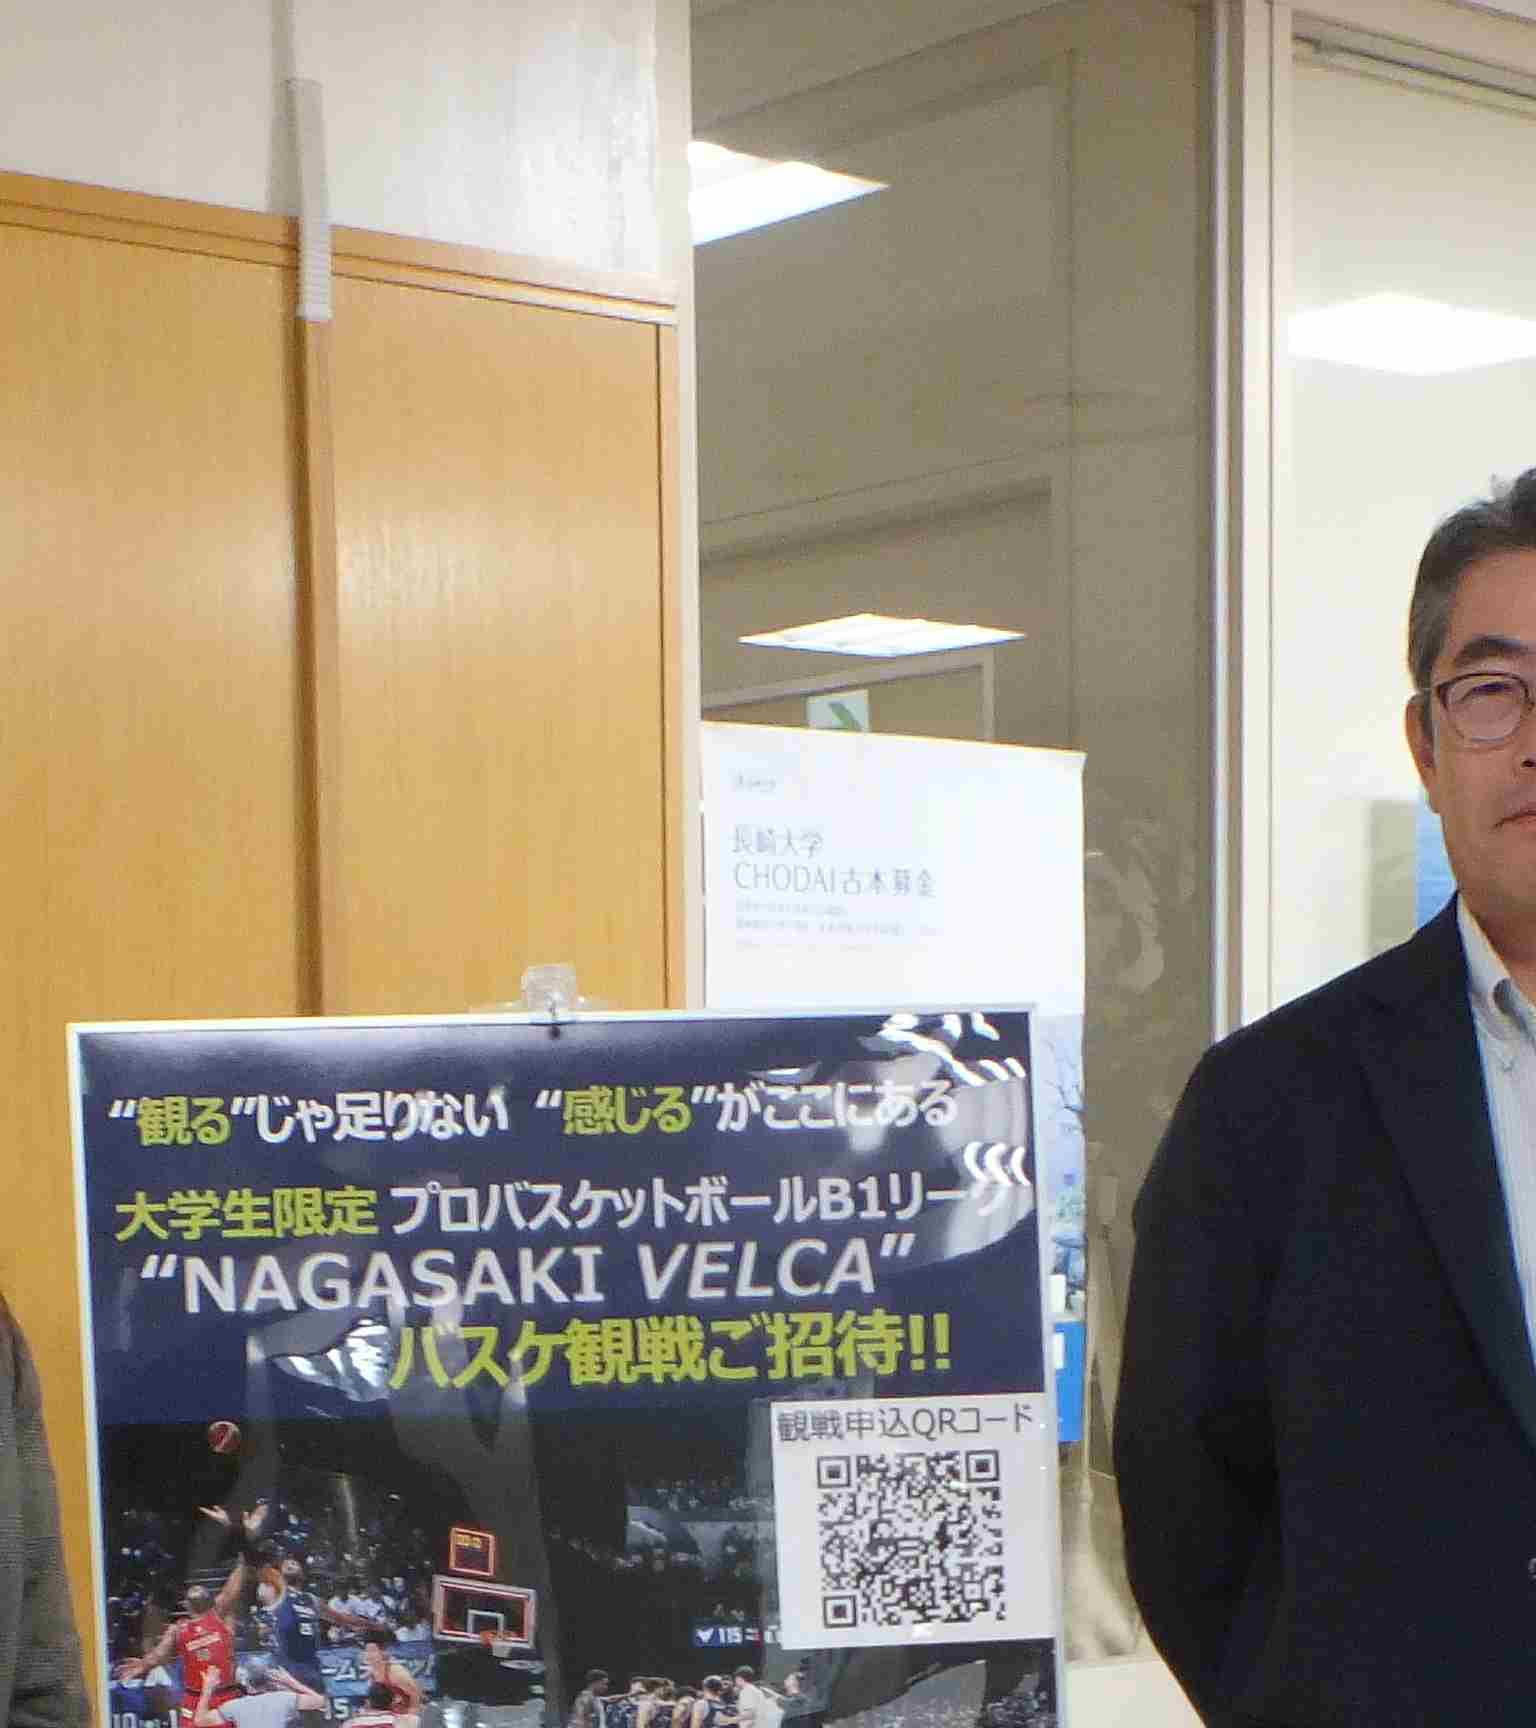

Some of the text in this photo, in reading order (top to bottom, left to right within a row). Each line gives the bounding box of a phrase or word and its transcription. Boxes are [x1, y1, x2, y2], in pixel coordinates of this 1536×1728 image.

[115, 1184, 379, 1242] 大学生限定
[778, 1403, 1035, 1442] 観戦申込QRコード
